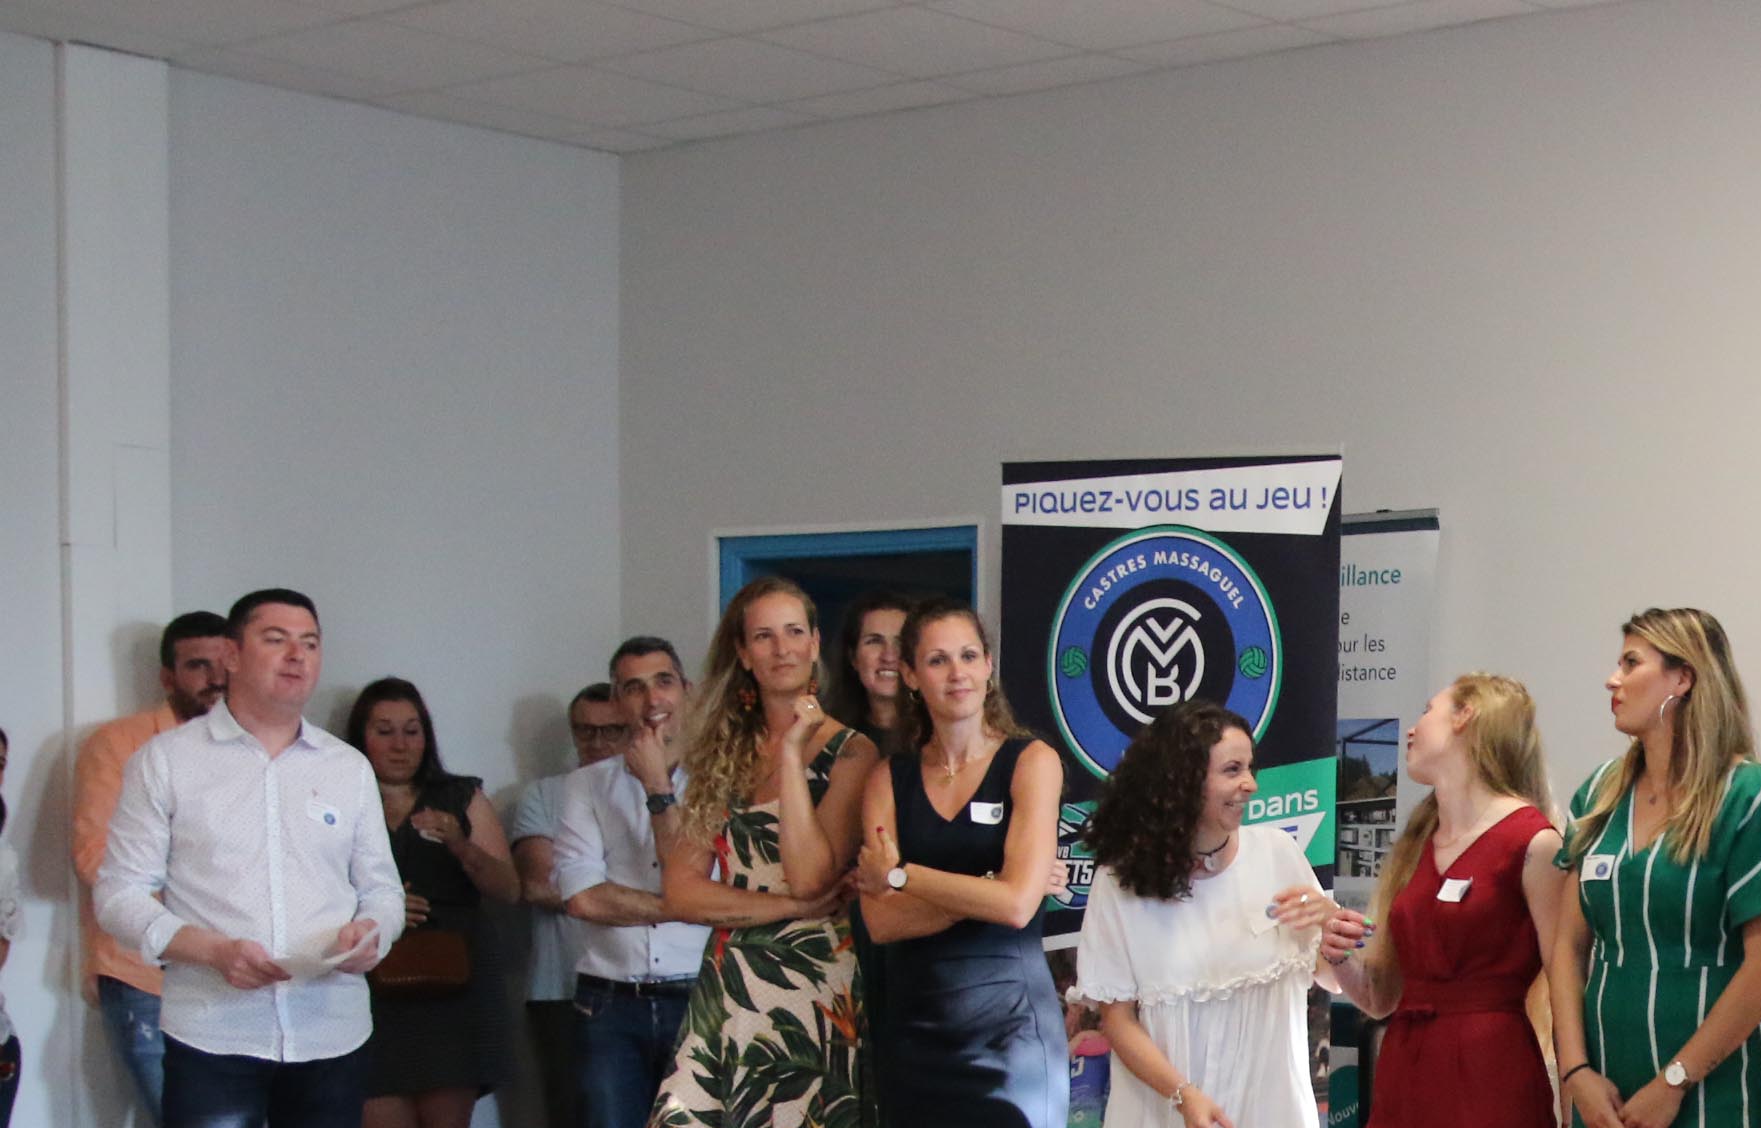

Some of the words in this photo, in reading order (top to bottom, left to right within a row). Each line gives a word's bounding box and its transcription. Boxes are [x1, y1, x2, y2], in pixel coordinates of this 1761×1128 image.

[1209, 487, 1248, 510] au
[1321, 485, 1328, 508] !
[1084, 554, 1147, 610] CASTRES
[1153, 551, 1247, 609] MASSAGUEL
[1364, 633, 1385, 652] les
[1338, 664, 1397, 681] istance
[1327, 1102, 1359, 1126] Nouv
